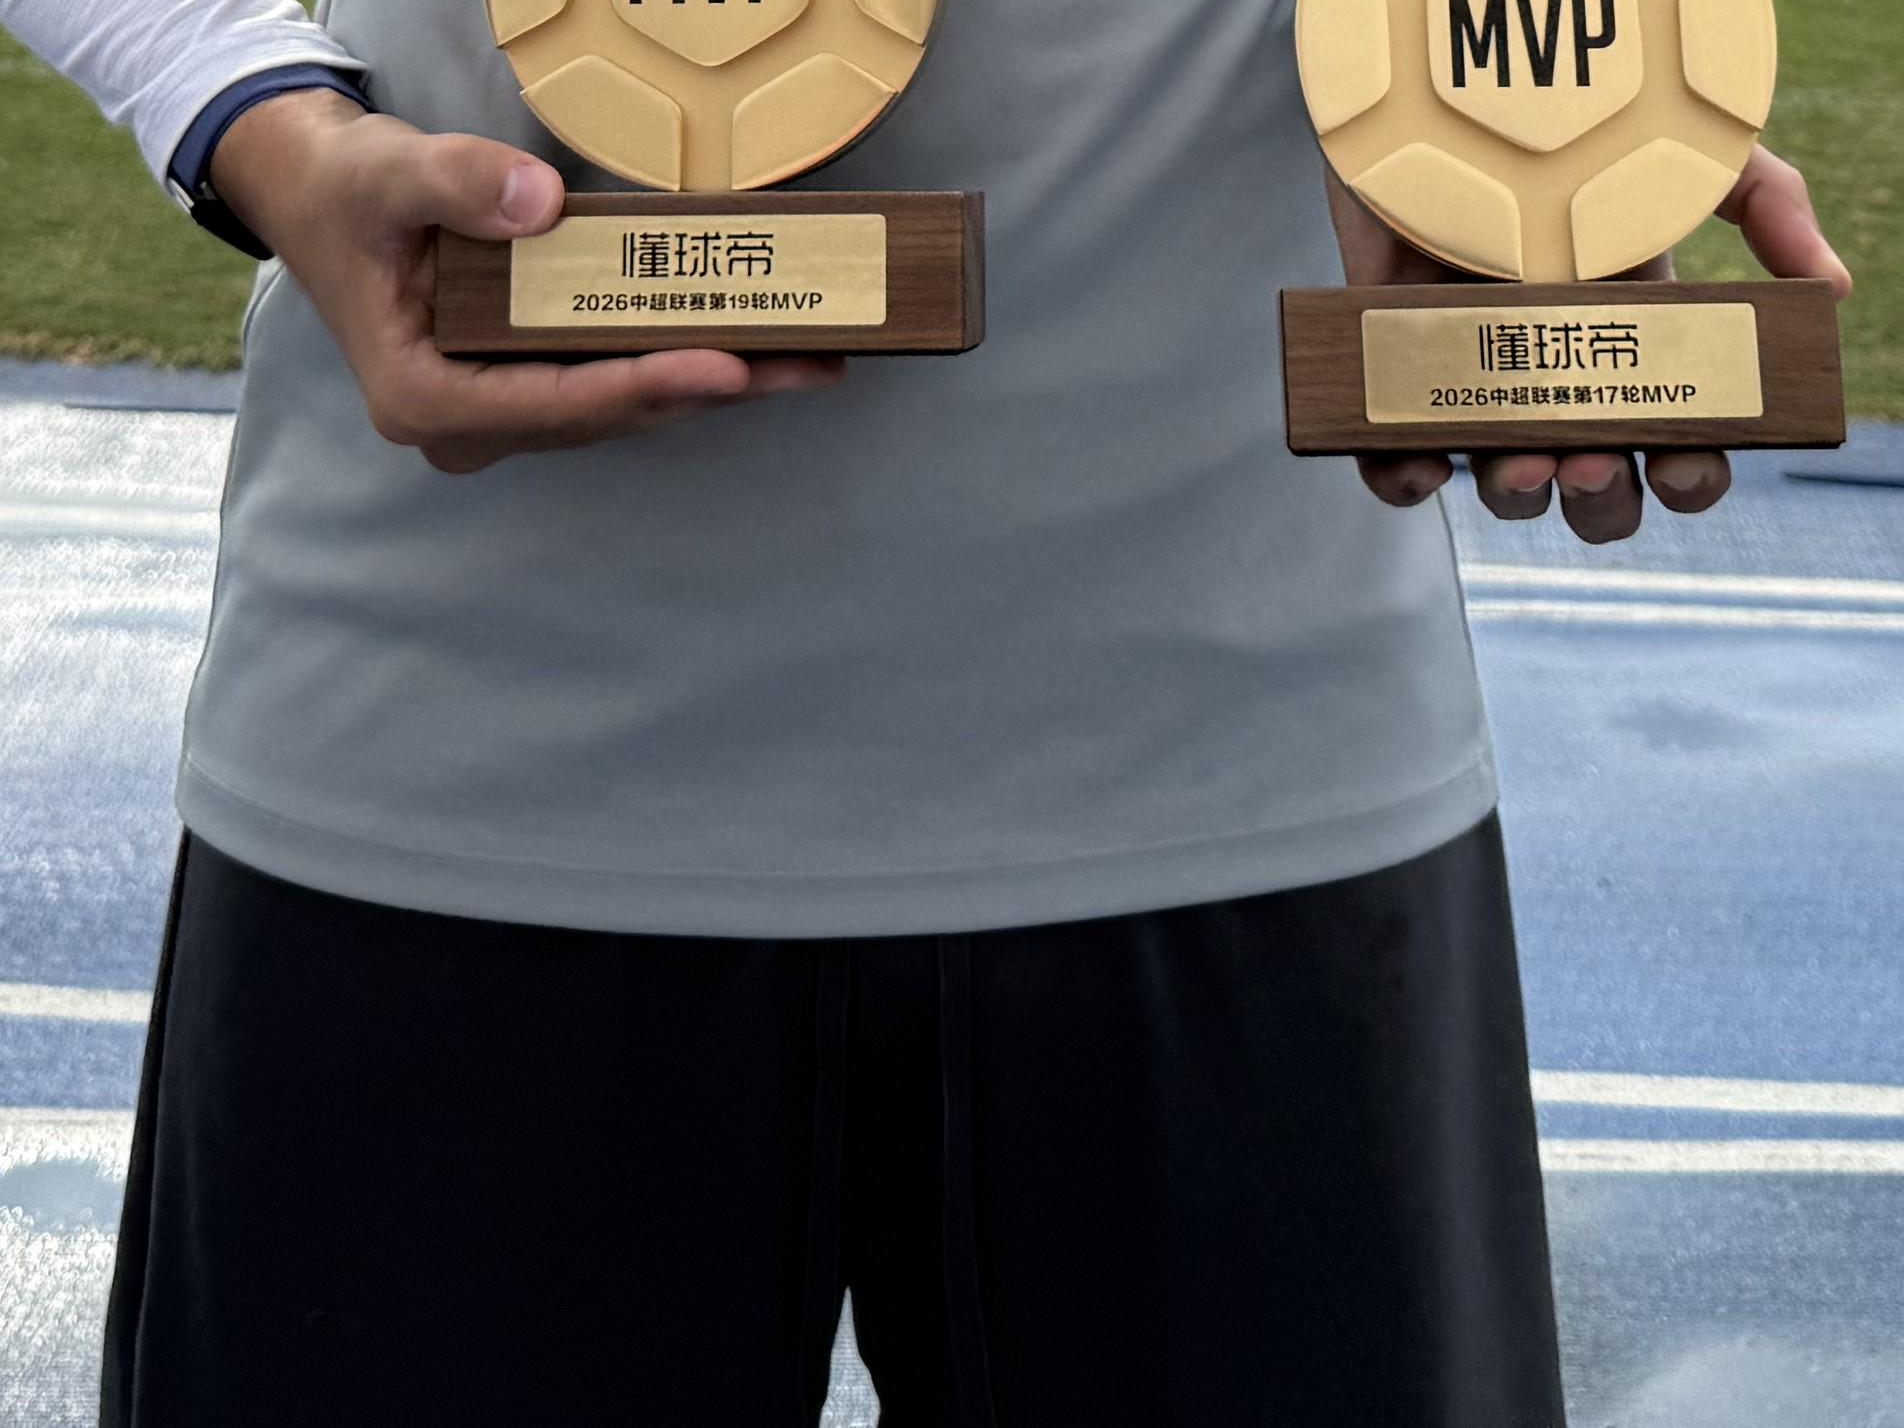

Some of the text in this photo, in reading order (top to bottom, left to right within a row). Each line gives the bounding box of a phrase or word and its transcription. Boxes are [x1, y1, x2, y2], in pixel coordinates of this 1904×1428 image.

[621, 231, 775, 279] 懂球帝
[572, 291, 824, 312] 2026中超联赛第19轮MVP
[1478, 321, 1639, 373] 懂球帝
[1429, 384, 1697, 407] 2026中超联赛第17轮MVP
